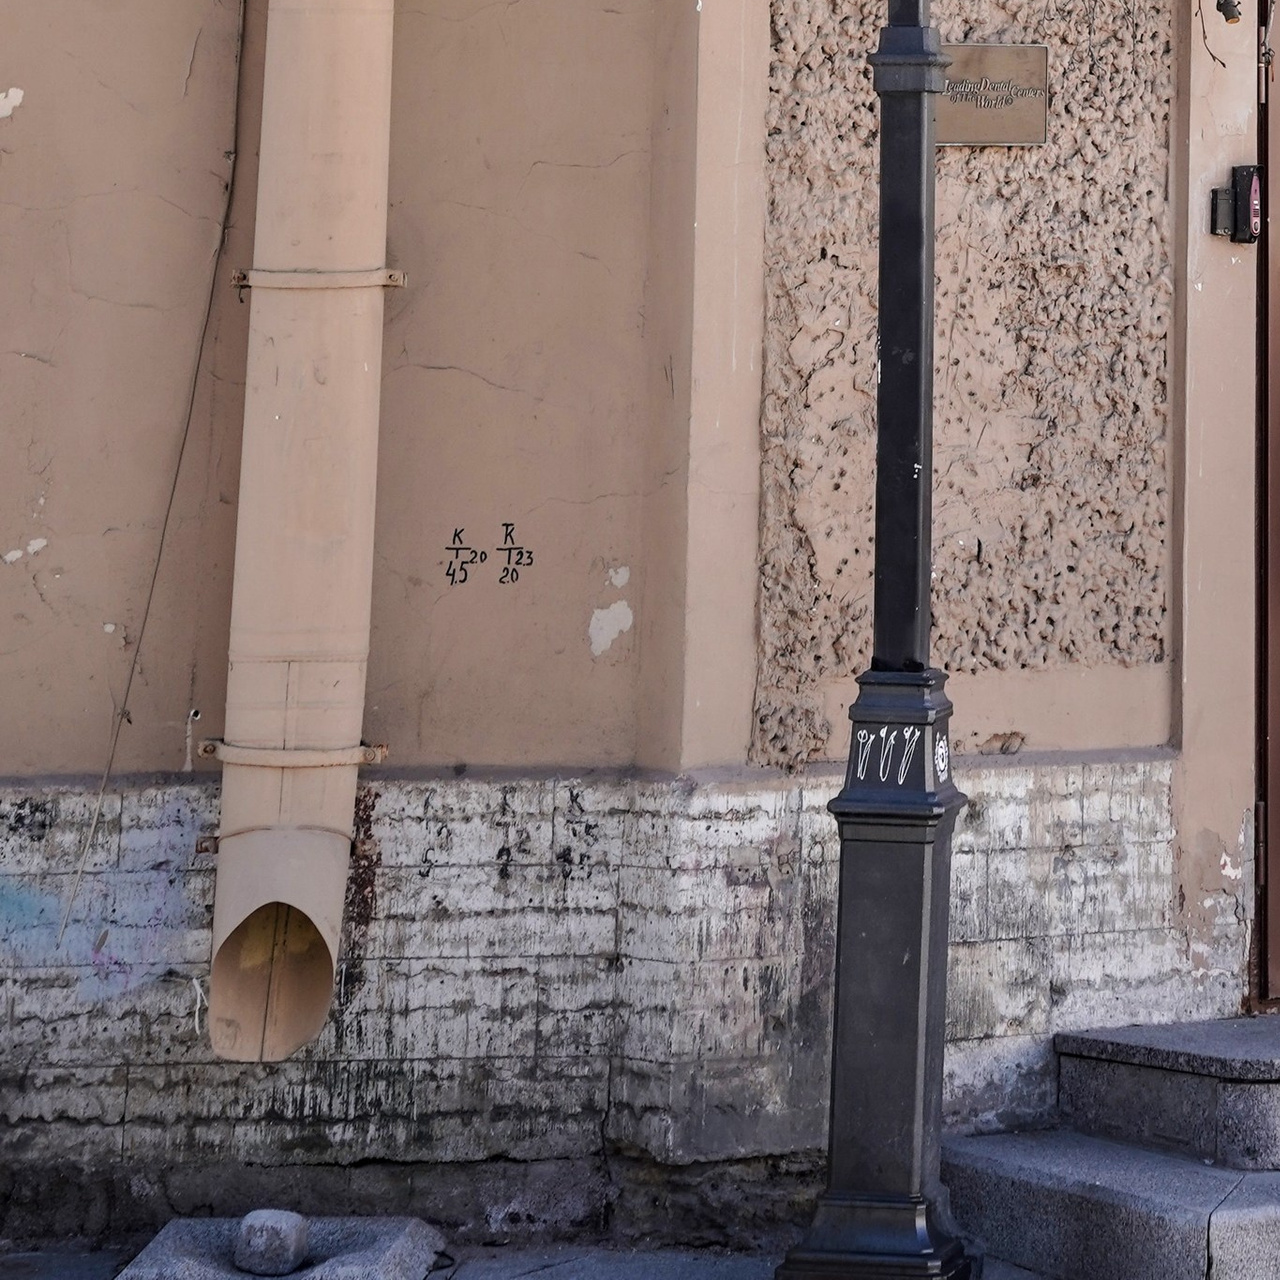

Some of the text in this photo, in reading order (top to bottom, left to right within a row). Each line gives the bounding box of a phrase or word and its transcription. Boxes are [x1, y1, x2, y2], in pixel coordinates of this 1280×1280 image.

[942, 77, 1045, 98] Leading Dental Centers
[949, 93, 960, 104] of
[959, 92, 975, 102] The
